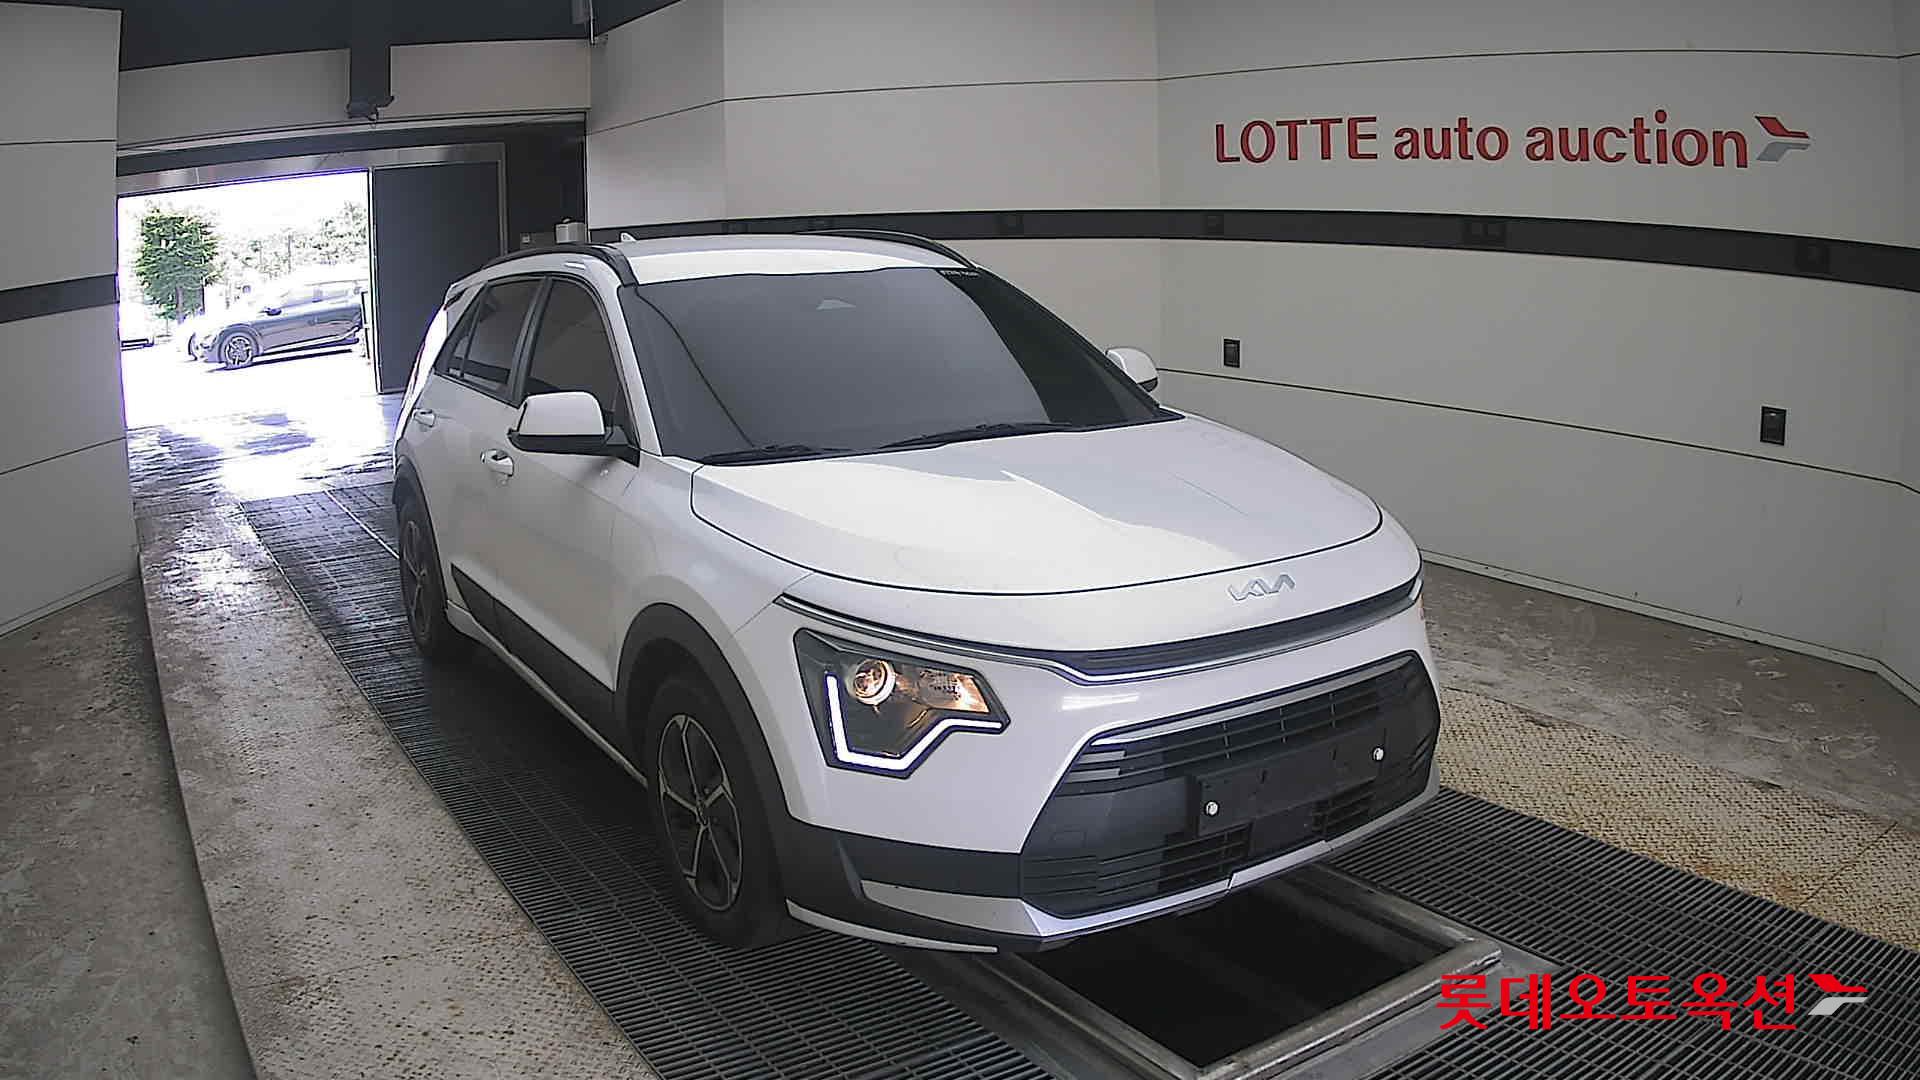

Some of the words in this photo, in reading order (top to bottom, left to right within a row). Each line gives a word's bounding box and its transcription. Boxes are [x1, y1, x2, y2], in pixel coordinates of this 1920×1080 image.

[1215, 116, 1378, 163] LOTTE
[1394, 118, 1510, 162] auto
[1526, 110, 1749, 168] auction
